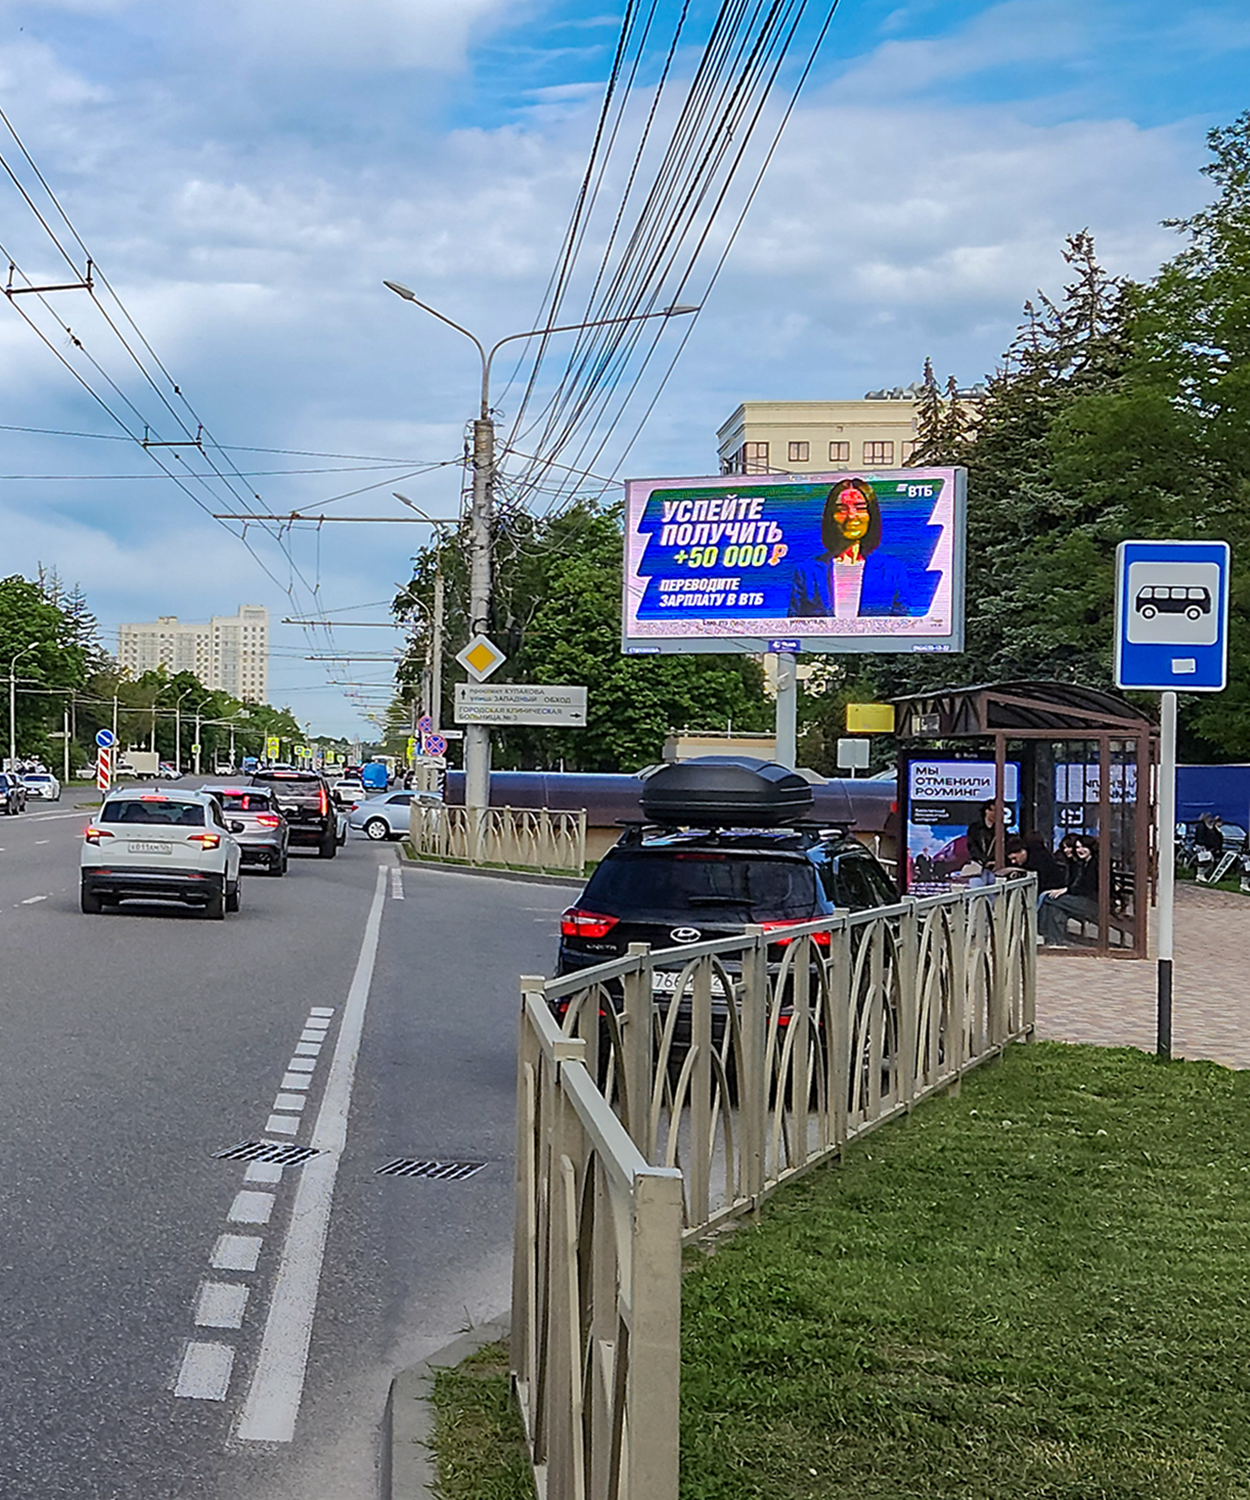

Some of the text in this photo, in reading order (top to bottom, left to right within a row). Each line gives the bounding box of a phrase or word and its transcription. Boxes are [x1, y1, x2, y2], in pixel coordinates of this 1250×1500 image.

[908, 485, 933, 497] ВТБ
[661, 494, 765, 522] УСПЕЙТЕ
[660, 521, 783, 546] ПОЛУЧИТЬ
[673, 546, 719, 568] +50
[659, 578, 741, 592] ПЕРЕВОДИТЕ
[659, 593, 764, 607] ЗАРПЛАТУ В ВТБ
[915, 767, 939, 775] МЫ
[915, 777, 990, 786] ОТМЕНИЛИ
[915, 788, 980, 796] РОУМИНГ
